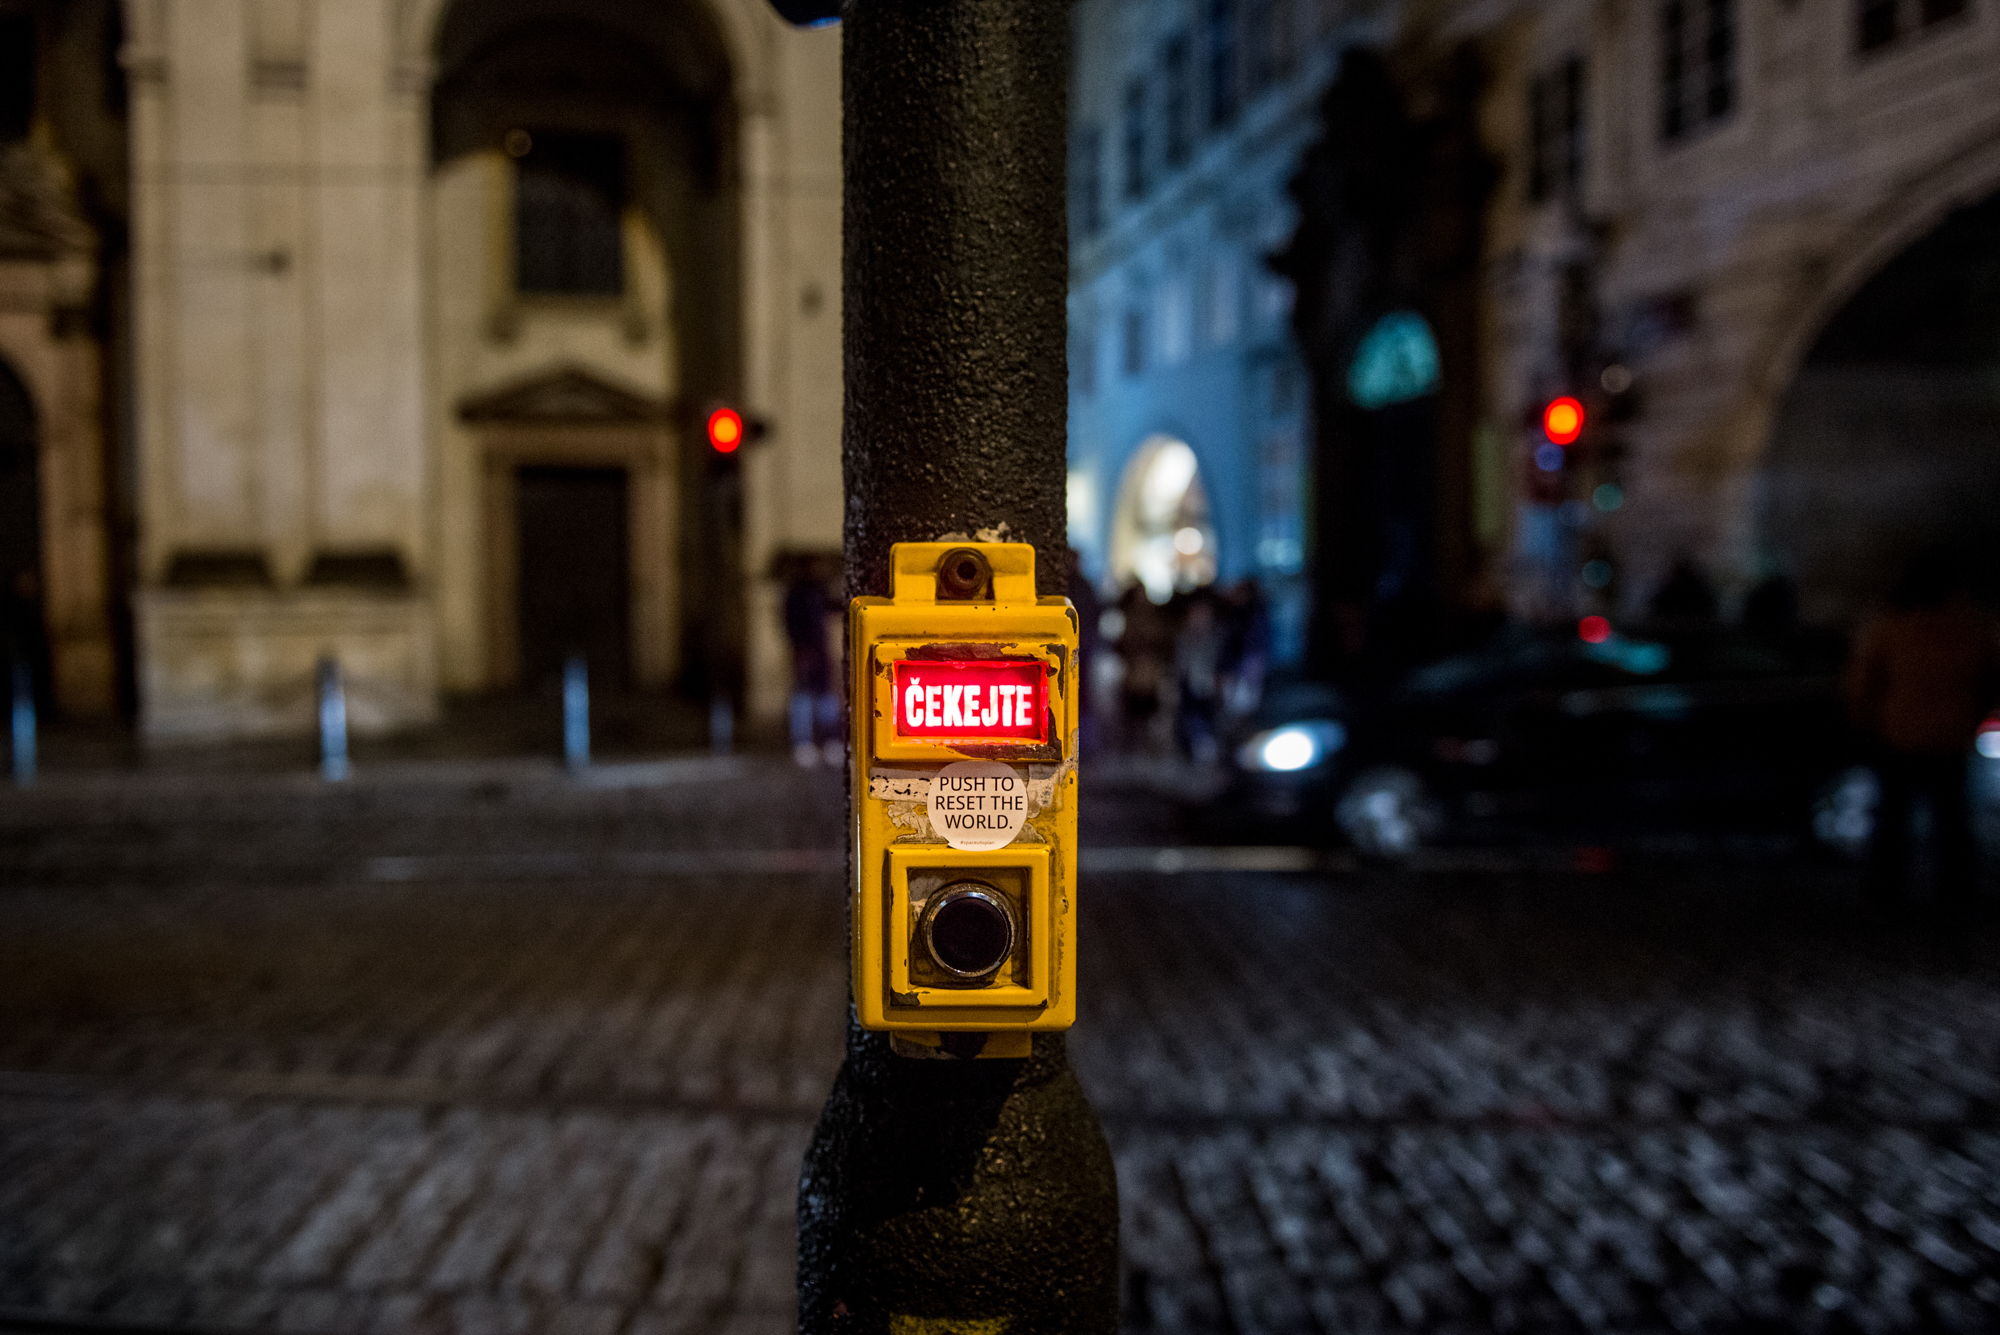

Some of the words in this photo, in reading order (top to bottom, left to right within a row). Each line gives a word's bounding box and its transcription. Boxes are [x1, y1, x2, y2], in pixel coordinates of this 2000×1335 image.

[905, 677, 1033, 727] ČEKEJTE
[940, 777, 985, 791] PUSH
[991, 777, 1014, 791] TO
[936, 796, 985, 810] RESET
[991, 796, 1023, 810] THE
[945, 815, 1013, 829] WORLD.
